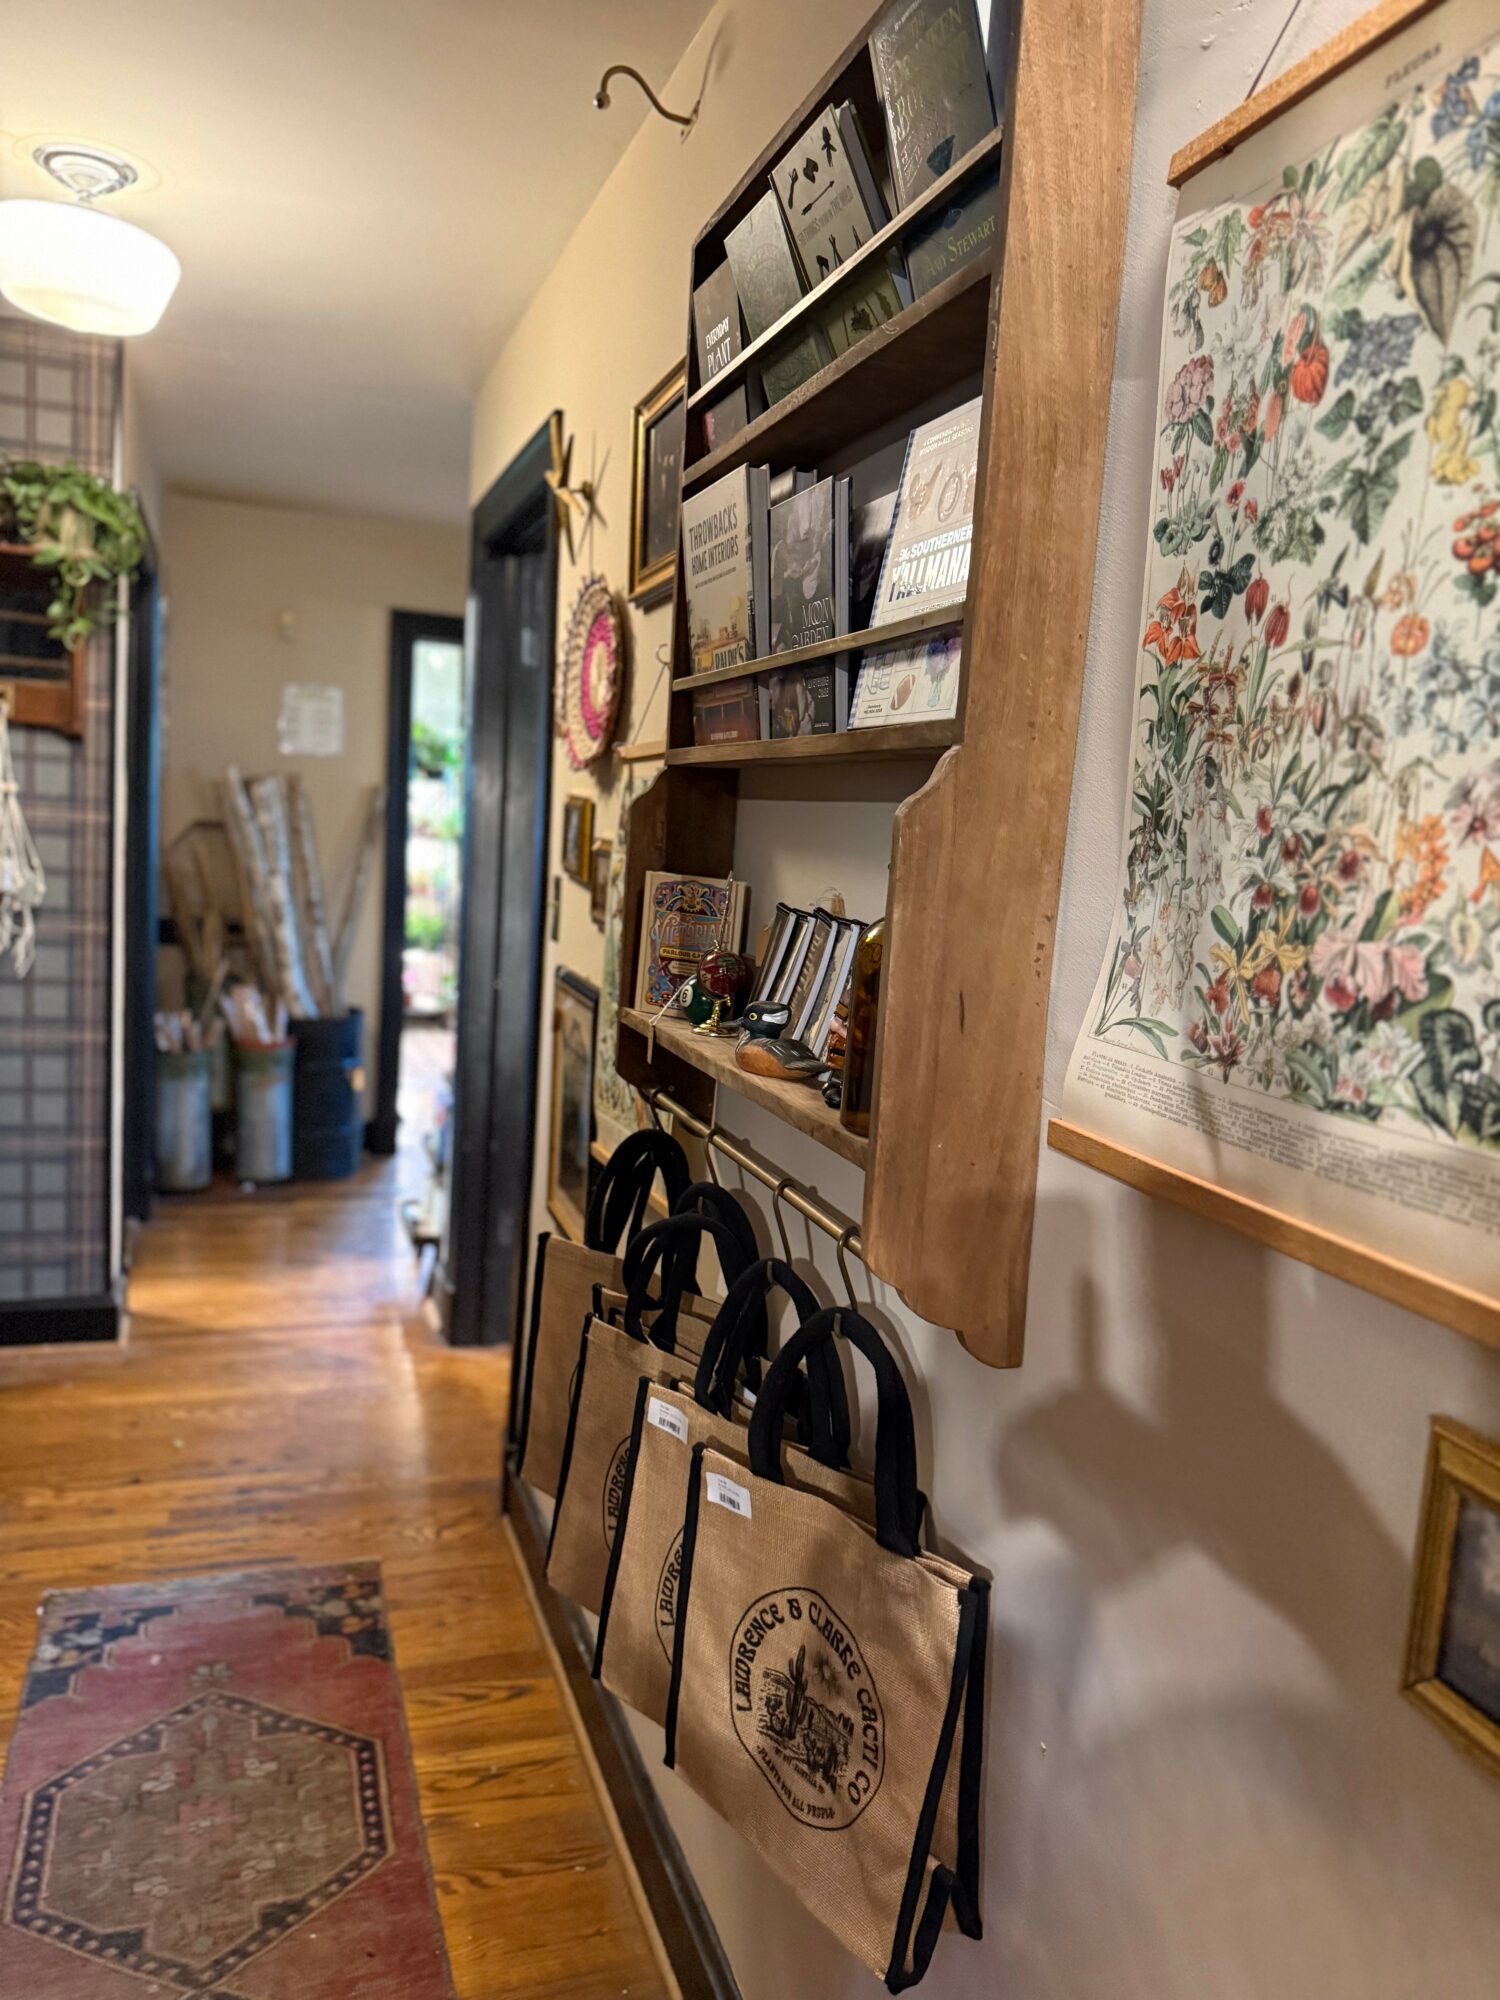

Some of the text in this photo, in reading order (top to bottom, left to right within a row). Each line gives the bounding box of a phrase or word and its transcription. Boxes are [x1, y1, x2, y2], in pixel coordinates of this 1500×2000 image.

[947, 215, 995, 262] STEWART
[705, 316, 729, 349] EVERYDAY
[707, 337, 731, 377] PLANT
[689, 502, 738, 552] THROWBACKS
[691, 534, 739, 577] HOME INTERIORS
[802, 597, 829, 629] MOON
[791, 625, 829, 650] GARDEN
[662, 948, 691, 959] PARLOUR
[682, 988, 689, 1003] 6
[736, 1602, 785, 1712] LAWRENCE
[808, 1601, 861, 1681] CLARKE
[856, 1688, 879, 1771] CACTI
[848, 1769, 871, 1806] CO
